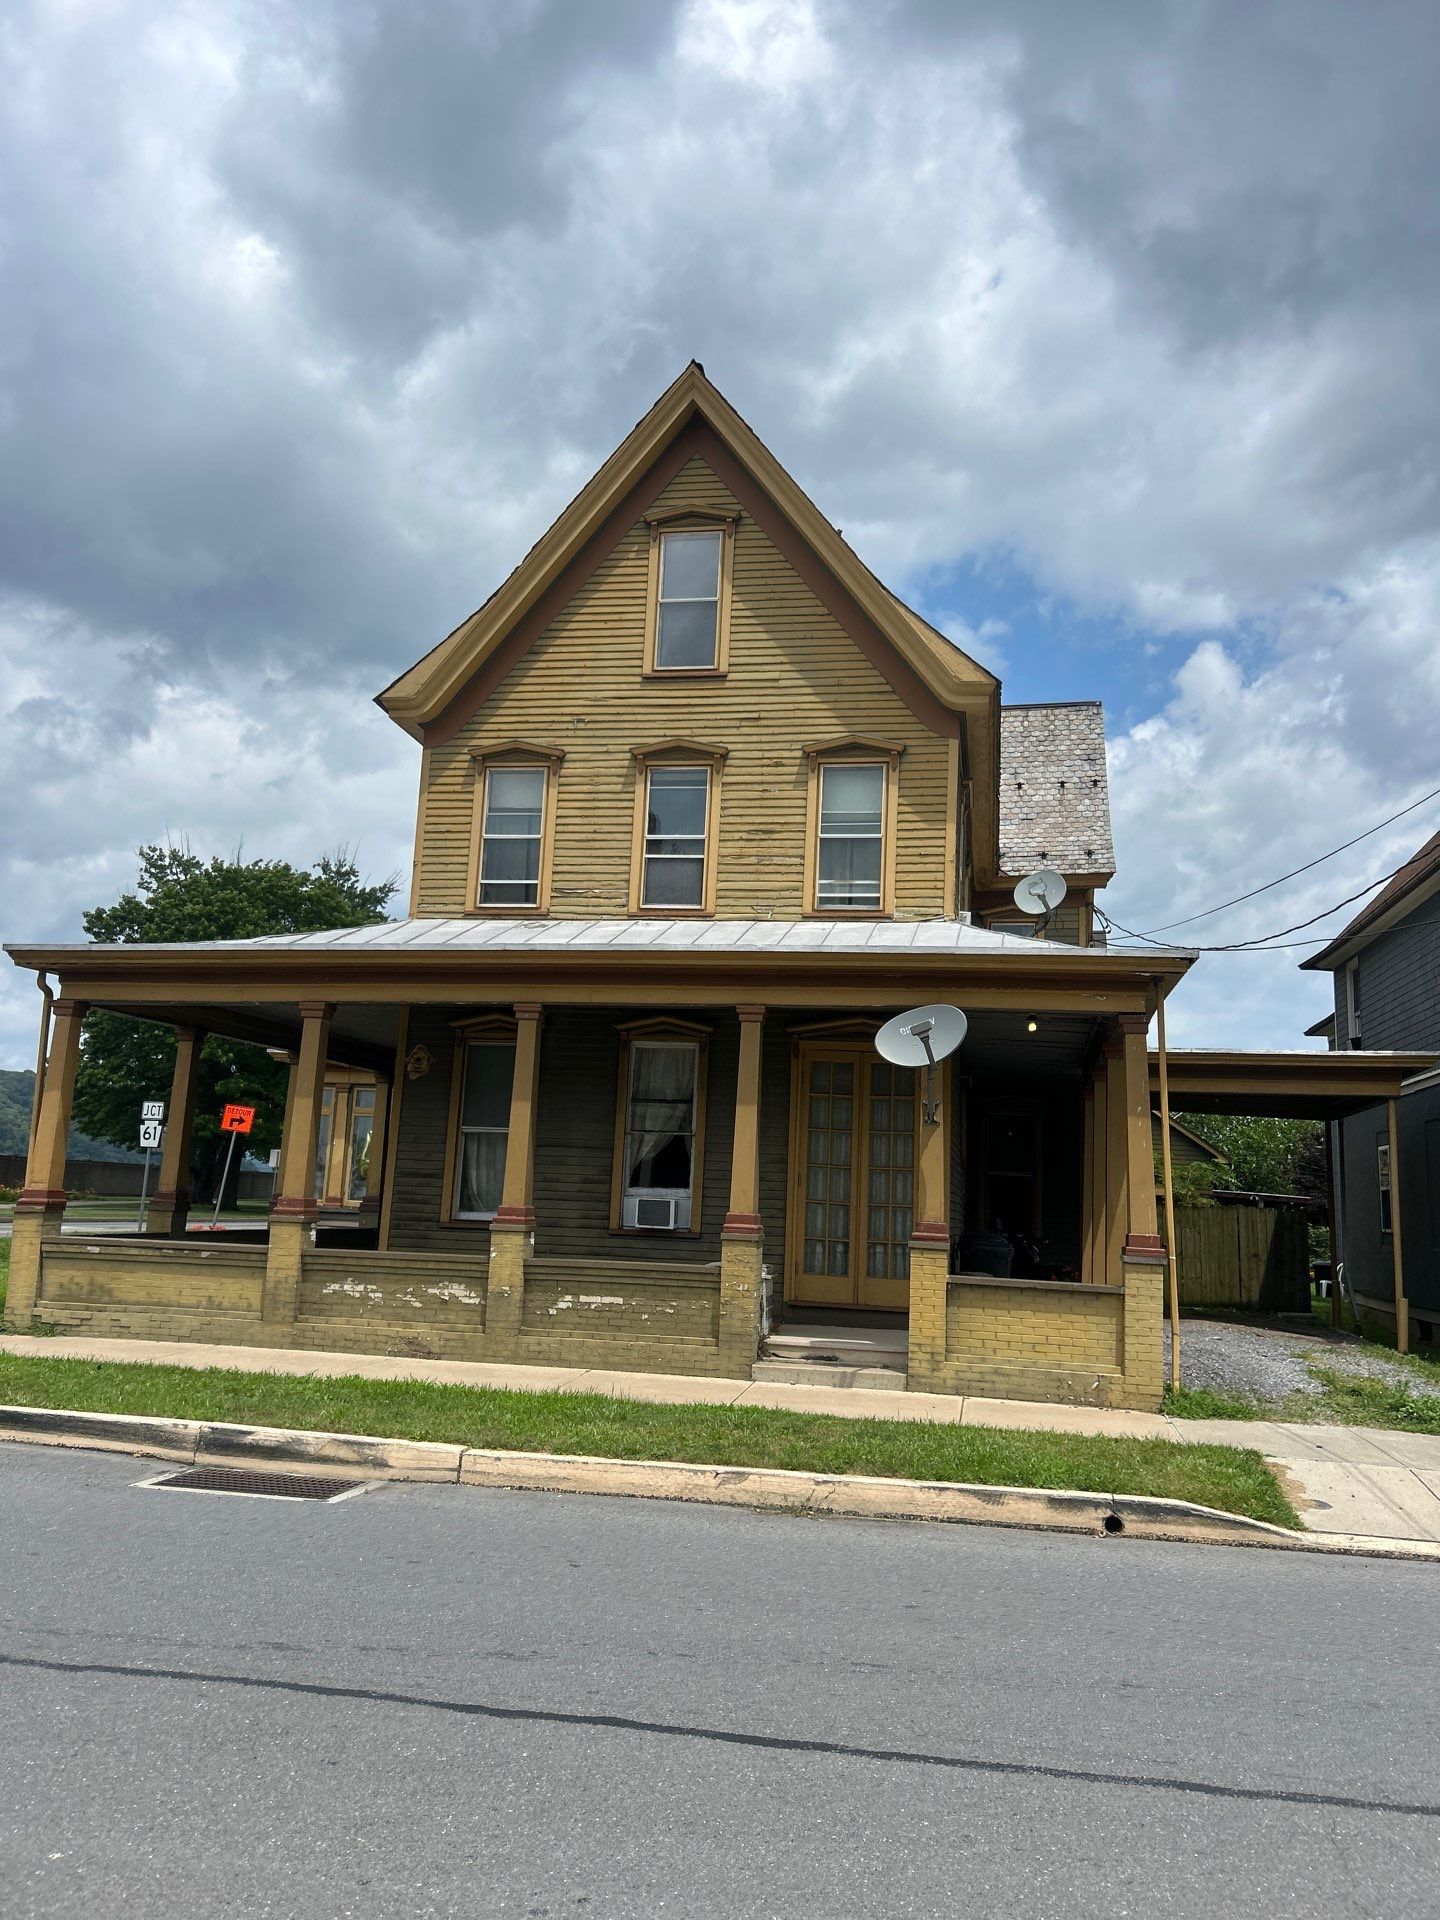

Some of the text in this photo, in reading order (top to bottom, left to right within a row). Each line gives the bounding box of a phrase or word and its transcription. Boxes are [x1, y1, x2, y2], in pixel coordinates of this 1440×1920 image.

[143, 1105, 163, 1117] JCT
[227, 1107, 252, 1117] DETOUR
[143, 1126, 157, 1141] 61
